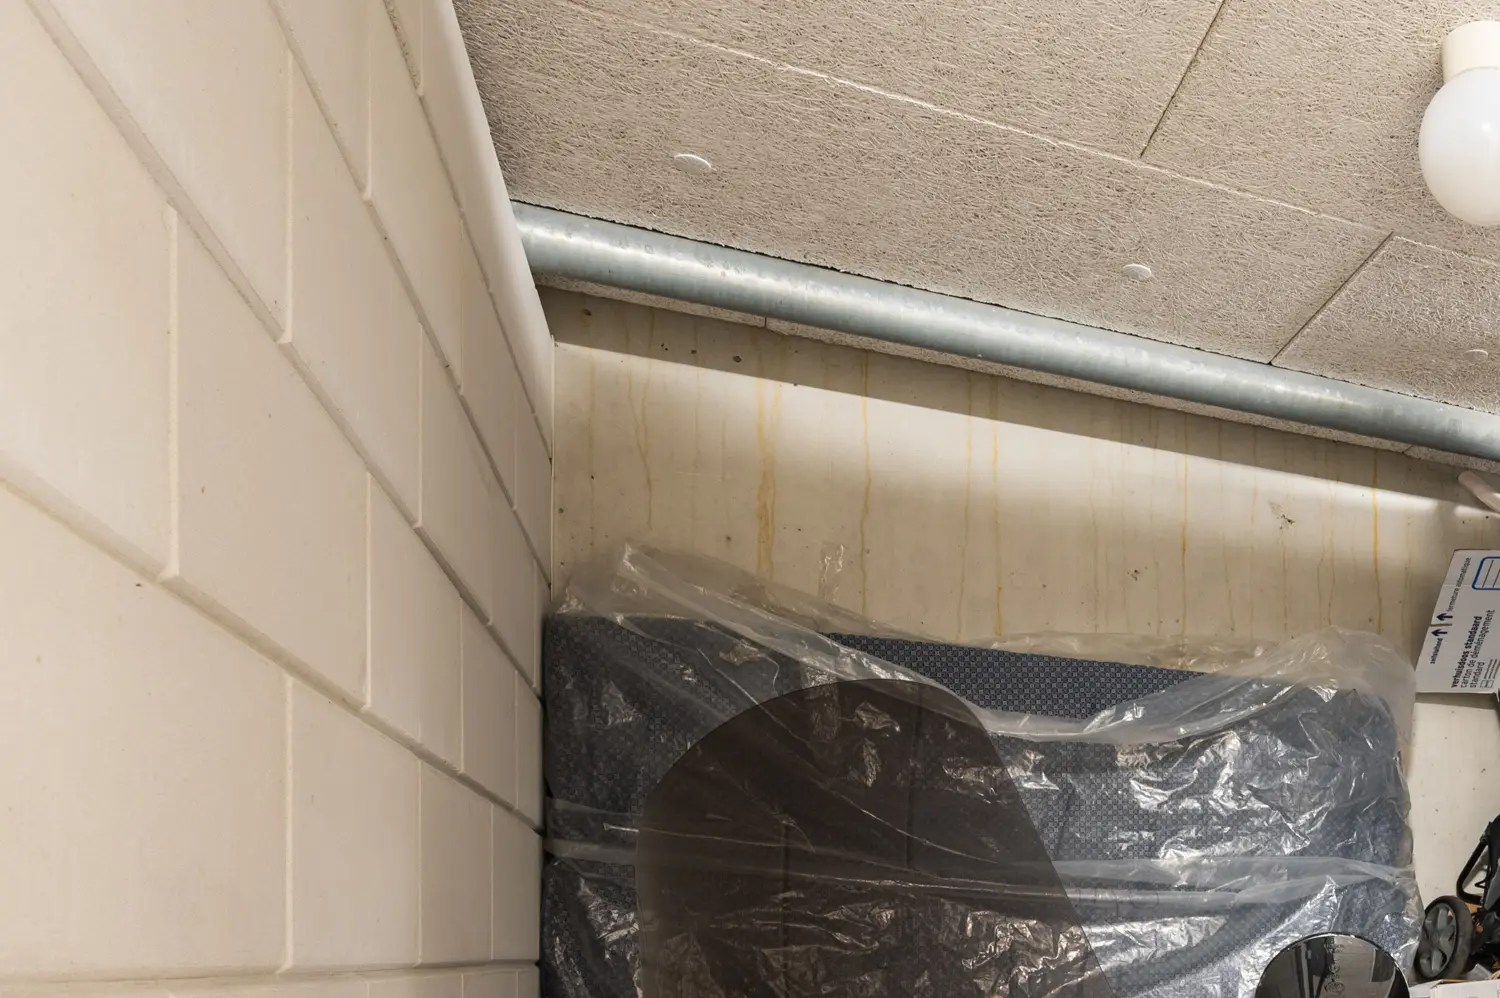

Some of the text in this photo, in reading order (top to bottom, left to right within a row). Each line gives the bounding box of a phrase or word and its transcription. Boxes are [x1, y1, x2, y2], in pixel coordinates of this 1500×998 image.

[1451, 616, 1482, 688] verhuisdoos standaard
[1461, 668, 1472, 688] carton
[1468, 659, 1475, 667] de
[1470, 661, 1484, 688] standard
